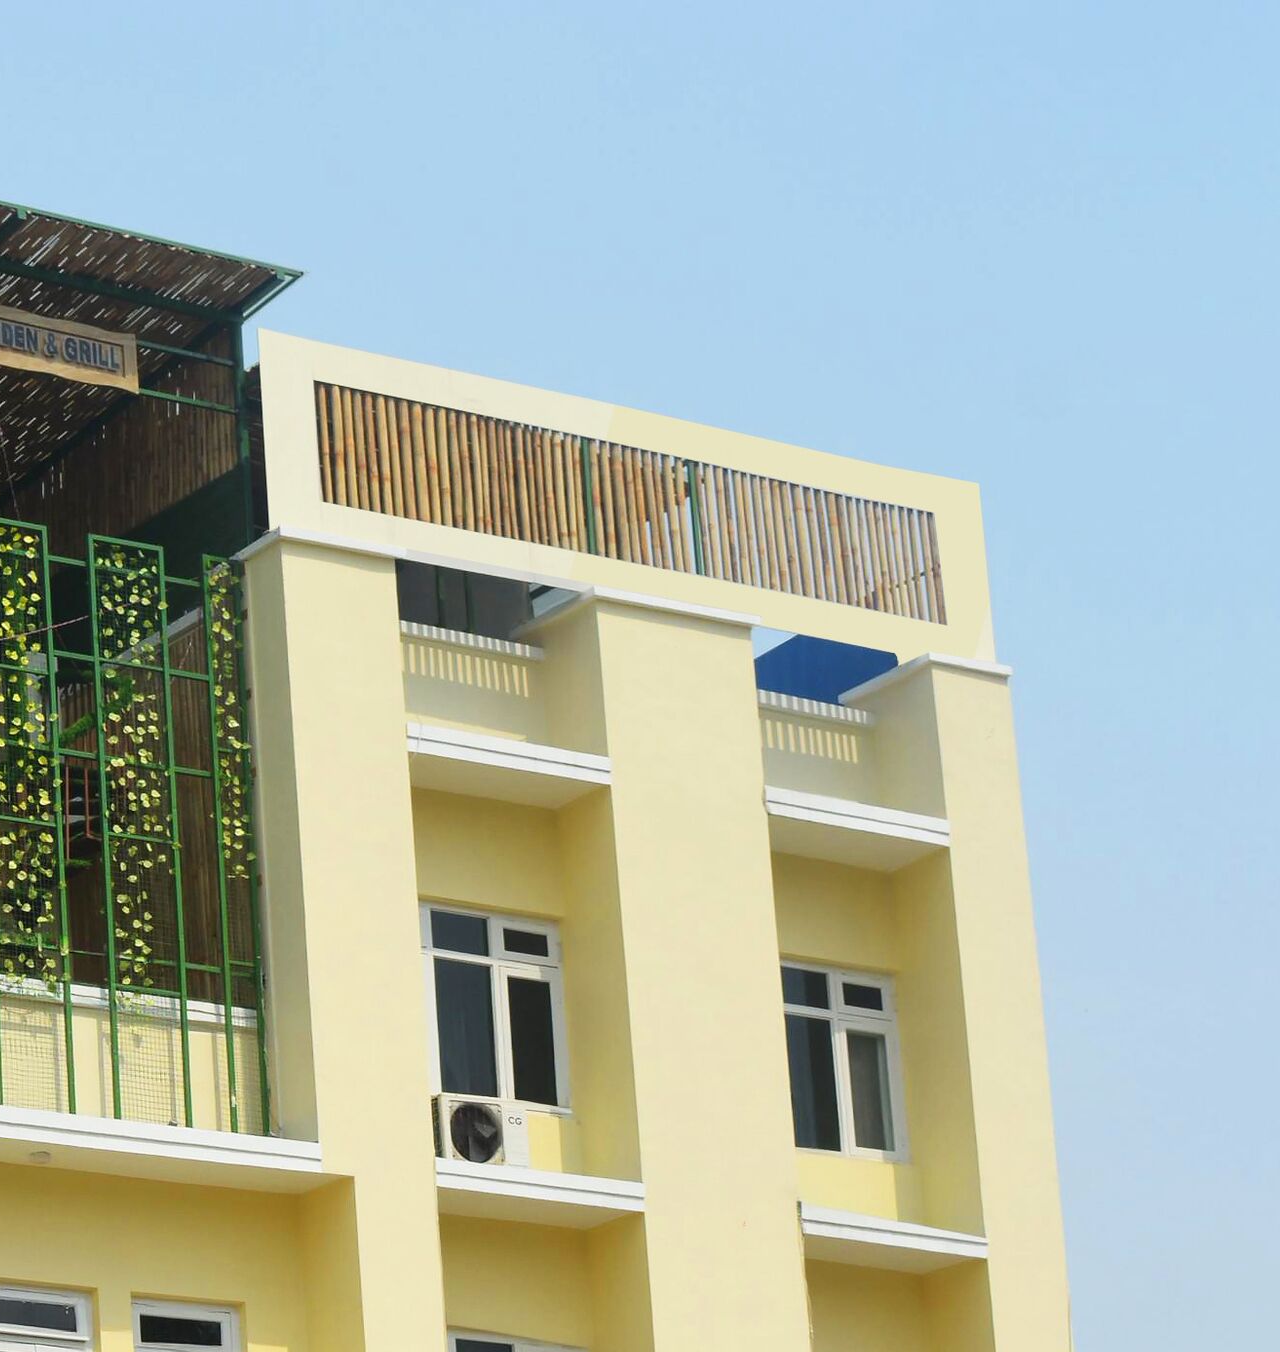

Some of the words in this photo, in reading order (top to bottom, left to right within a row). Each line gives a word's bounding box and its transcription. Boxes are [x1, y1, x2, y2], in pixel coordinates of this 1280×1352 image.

[45, 332, 59, 356] &
[63, 337, 121, 371] GRILL
[508, 1116, 522, 1126] CG
